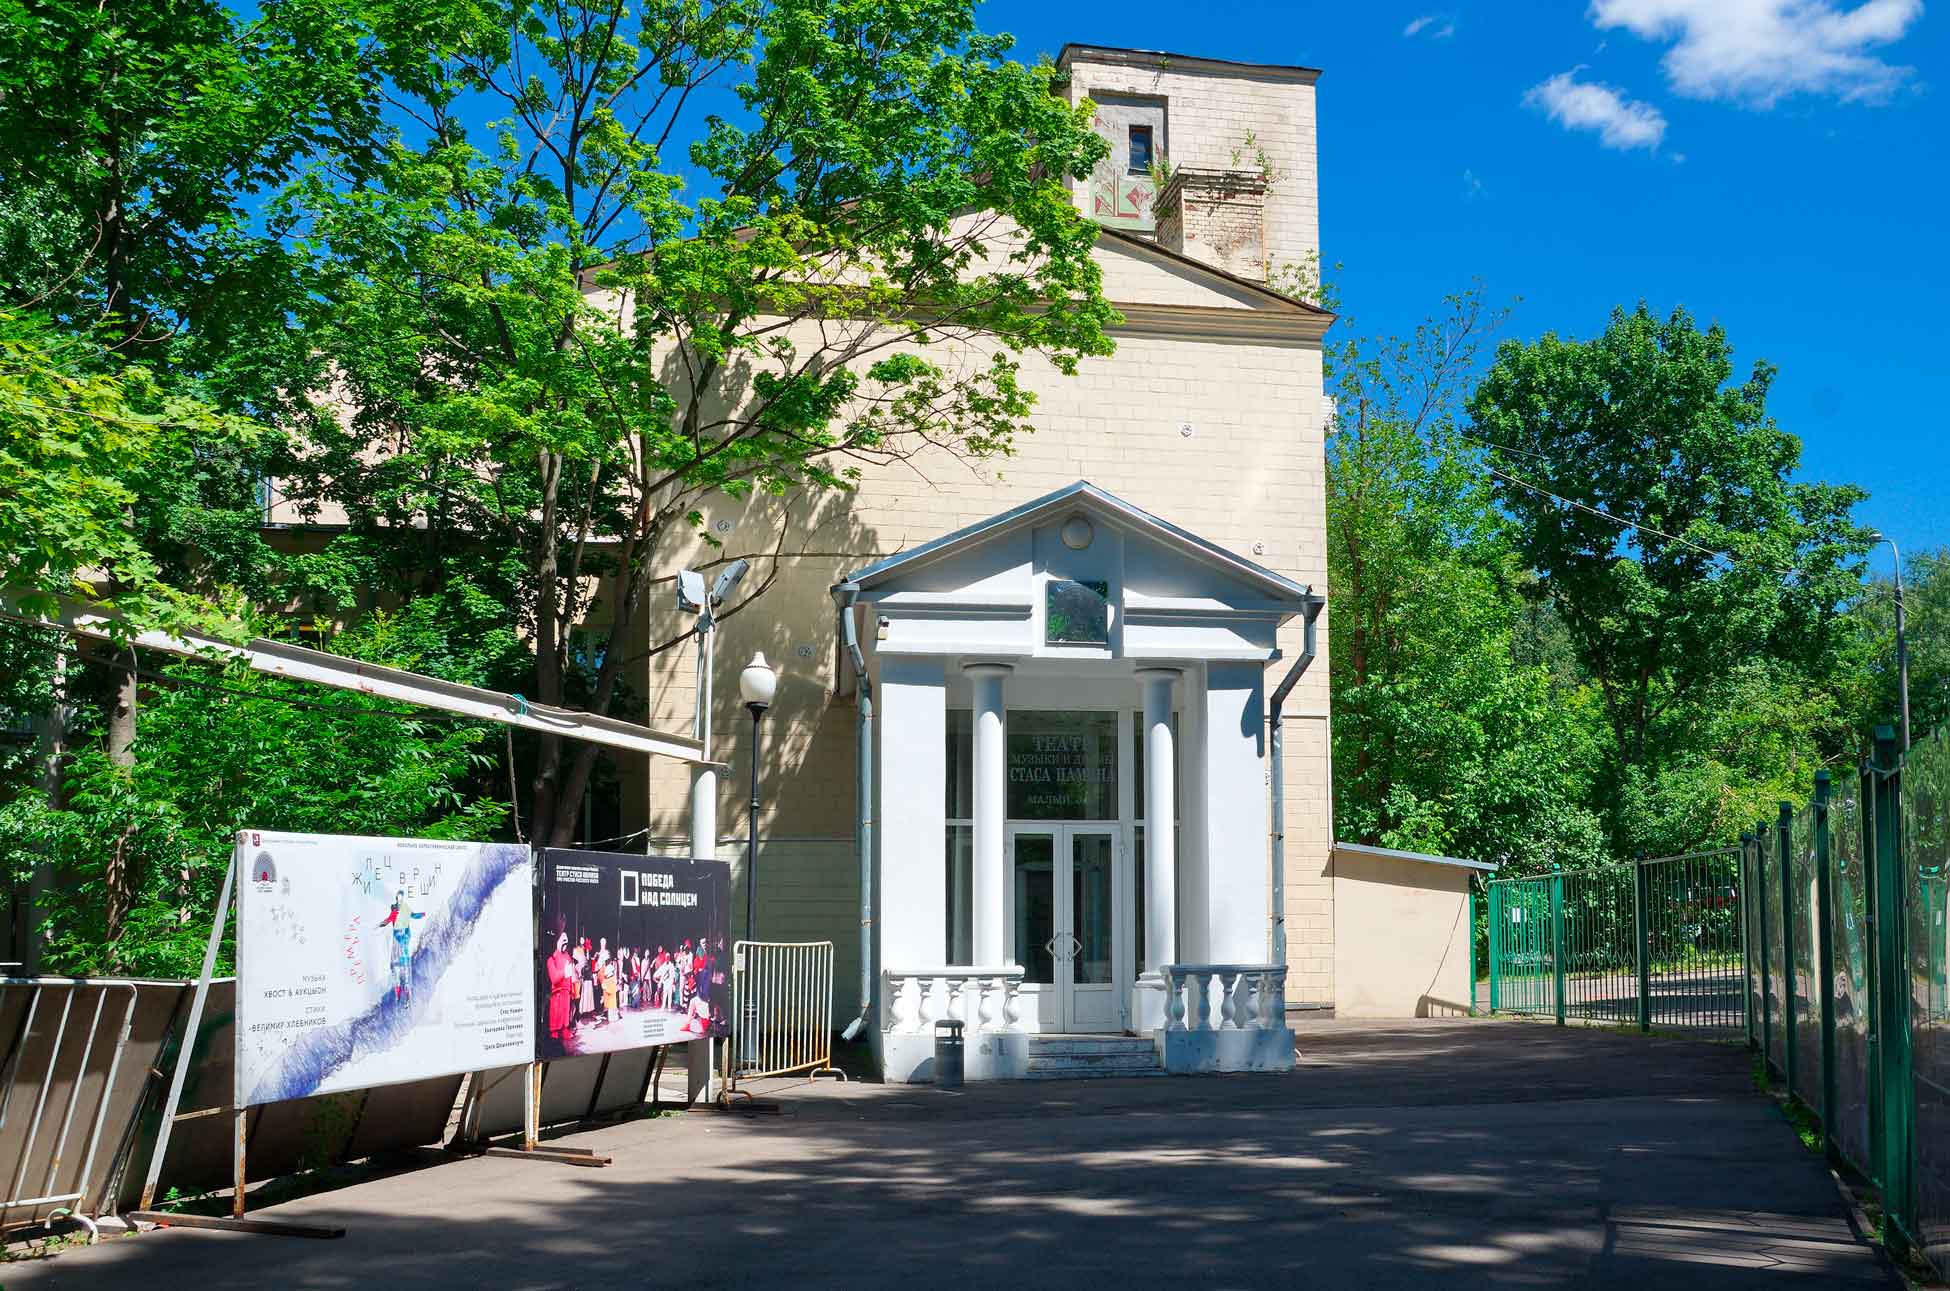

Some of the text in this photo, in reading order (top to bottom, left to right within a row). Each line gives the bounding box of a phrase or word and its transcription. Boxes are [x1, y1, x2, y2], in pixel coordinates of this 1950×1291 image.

[1010, 768, 1114, 783] СТАСА НАМНА
[641, 873, 674, 889] ПОБЕДА
[642, 891, 697, 908] НАД СОЛНЦЕМ
[264, 989, 287, 998] ХВОСТ
[251, 1017, 327, 1032] ВЕЛИМИР ХЛЕБНИКОВ
